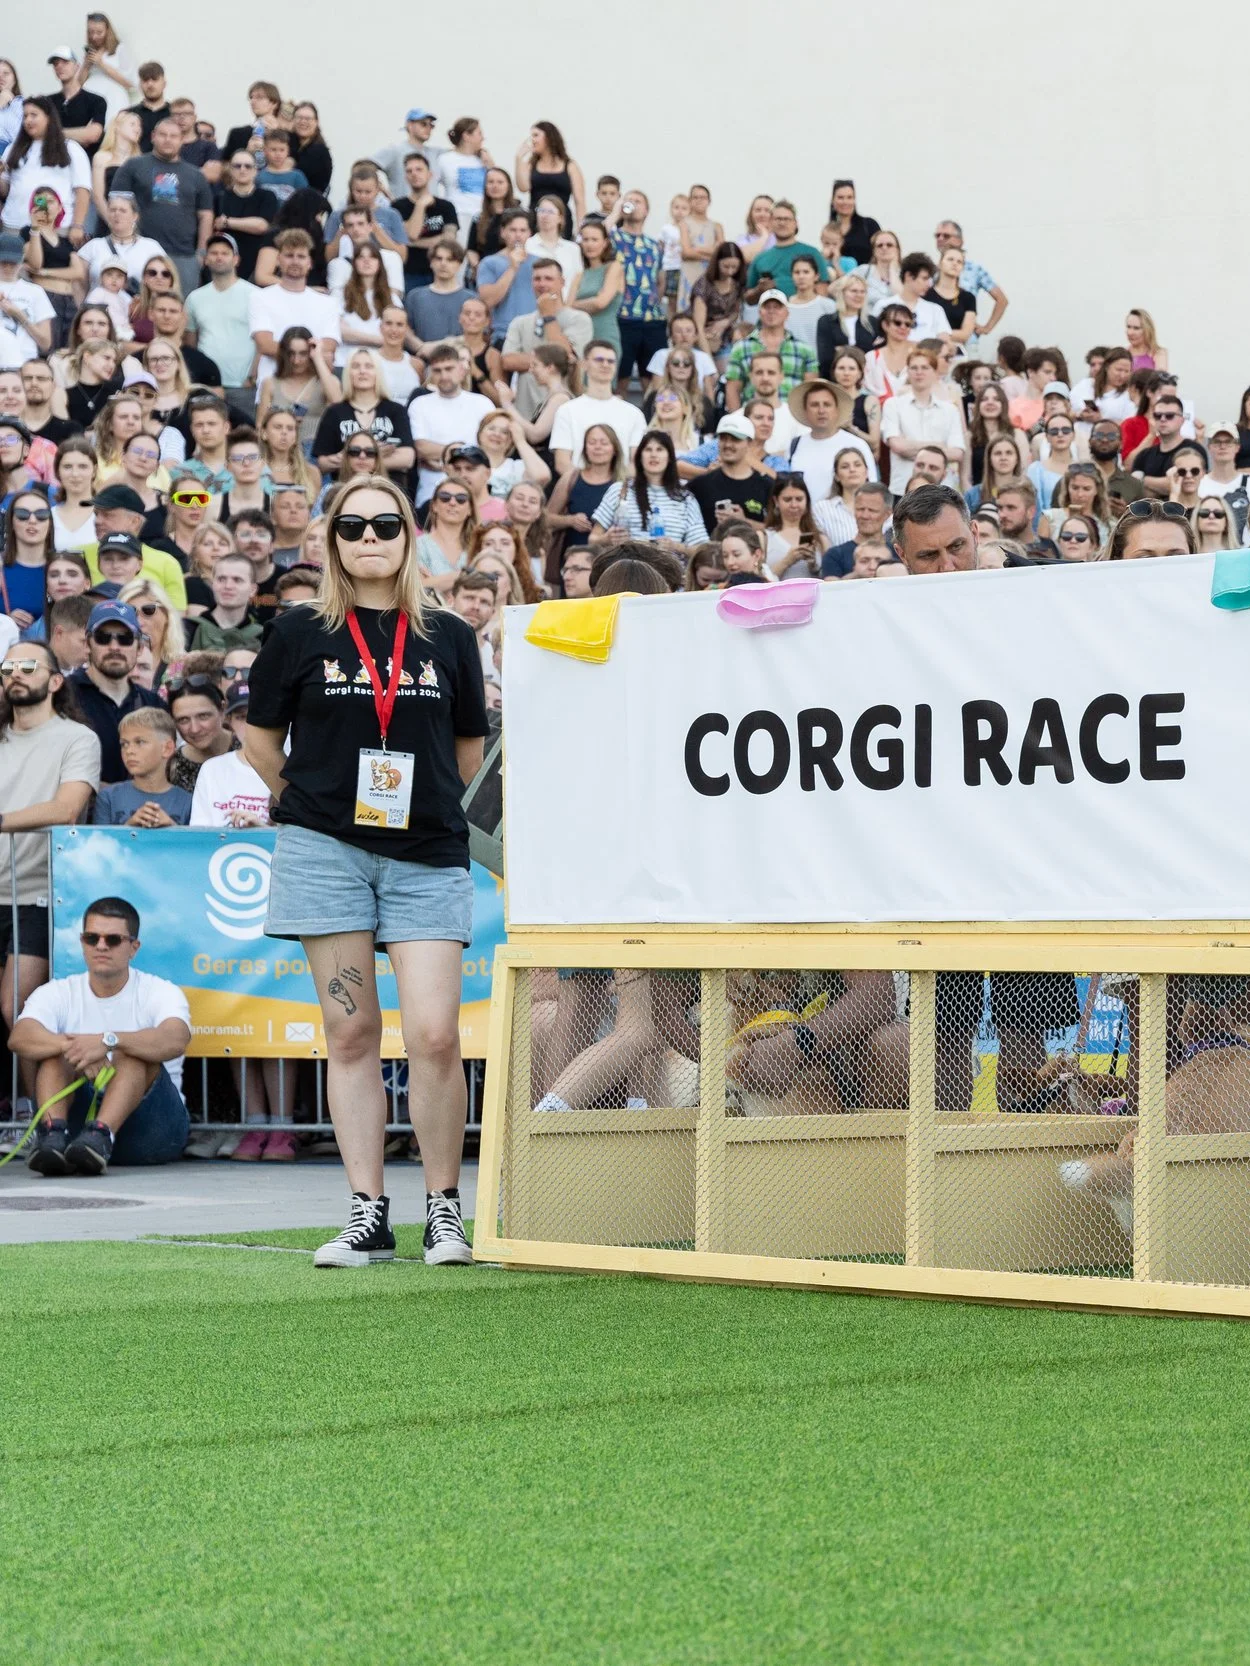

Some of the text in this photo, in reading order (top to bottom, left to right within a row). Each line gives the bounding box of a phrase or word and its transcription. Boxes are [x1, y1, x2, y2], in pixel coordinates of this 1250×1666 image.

[324, 686, 351, 696] Corgi
[419, 688, 441, 699] 2024
[684, 703, 933, 797] CORGI
[961, 692, 1186, 787] RACE
[193, 953, 268, 975] Geras
[190, 1023, 255, 1036] anorama.lt
